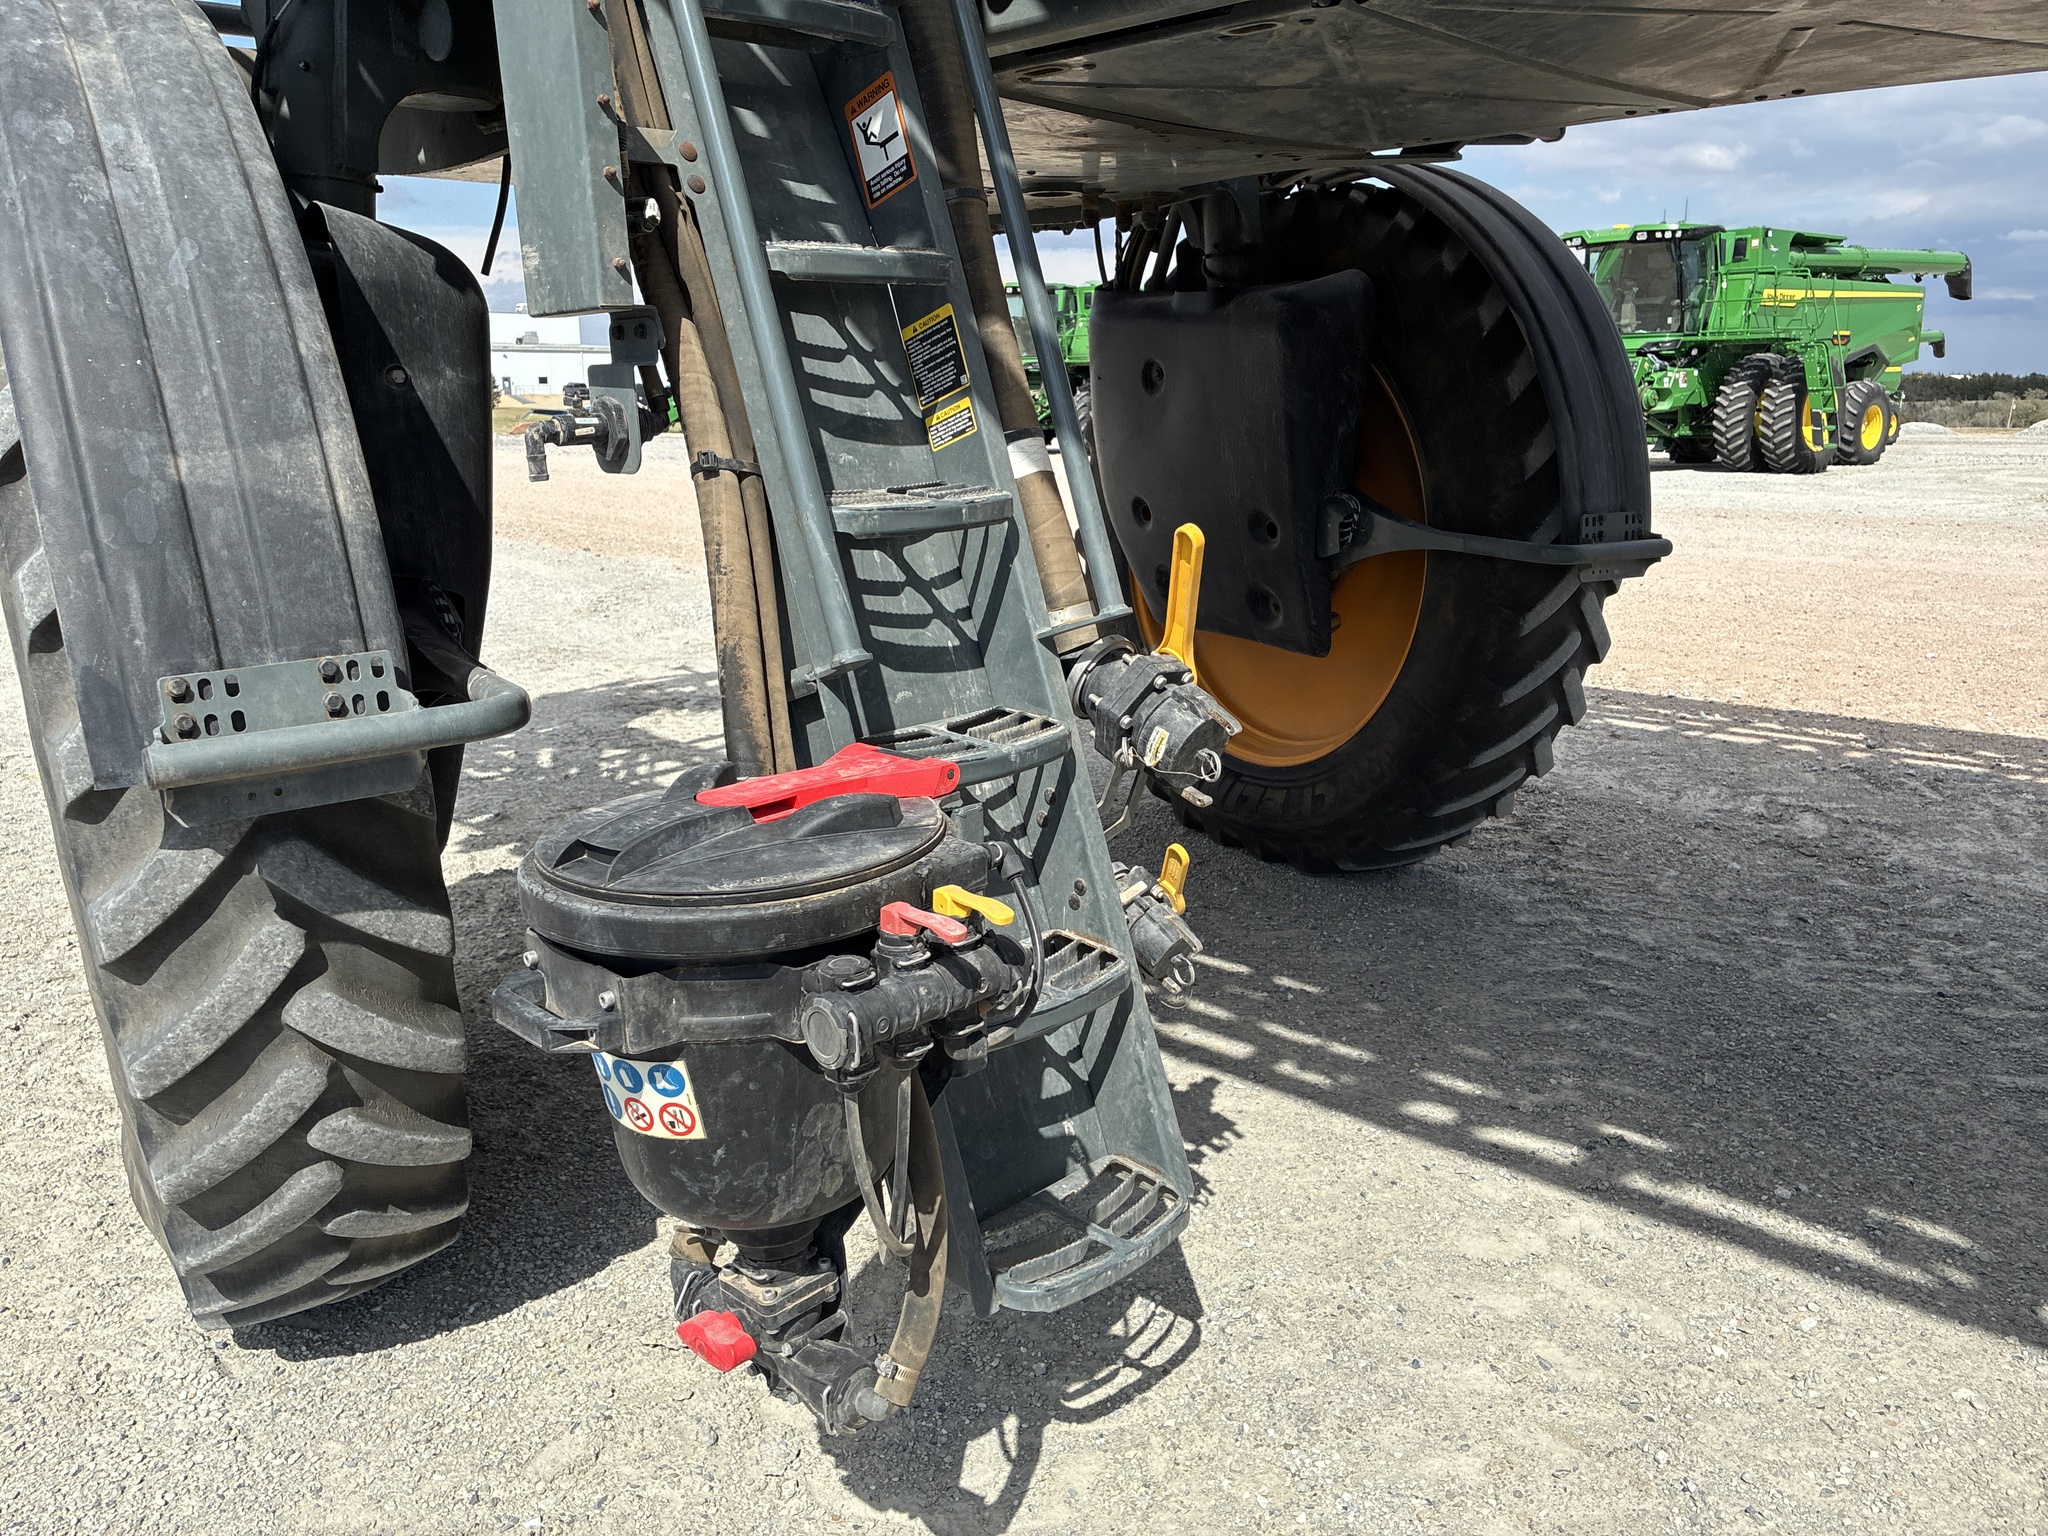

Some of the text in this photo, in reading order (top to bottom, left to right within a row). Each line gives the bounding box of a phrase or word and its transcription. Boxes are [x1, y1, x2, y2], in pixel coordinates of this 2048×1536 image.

[856, 78, 890, 110] WARNING
[894, 158, 906, 169] injury
[918, 312, 941, 330] CAUTION
[940, 404, 961, 418] CAUTION
